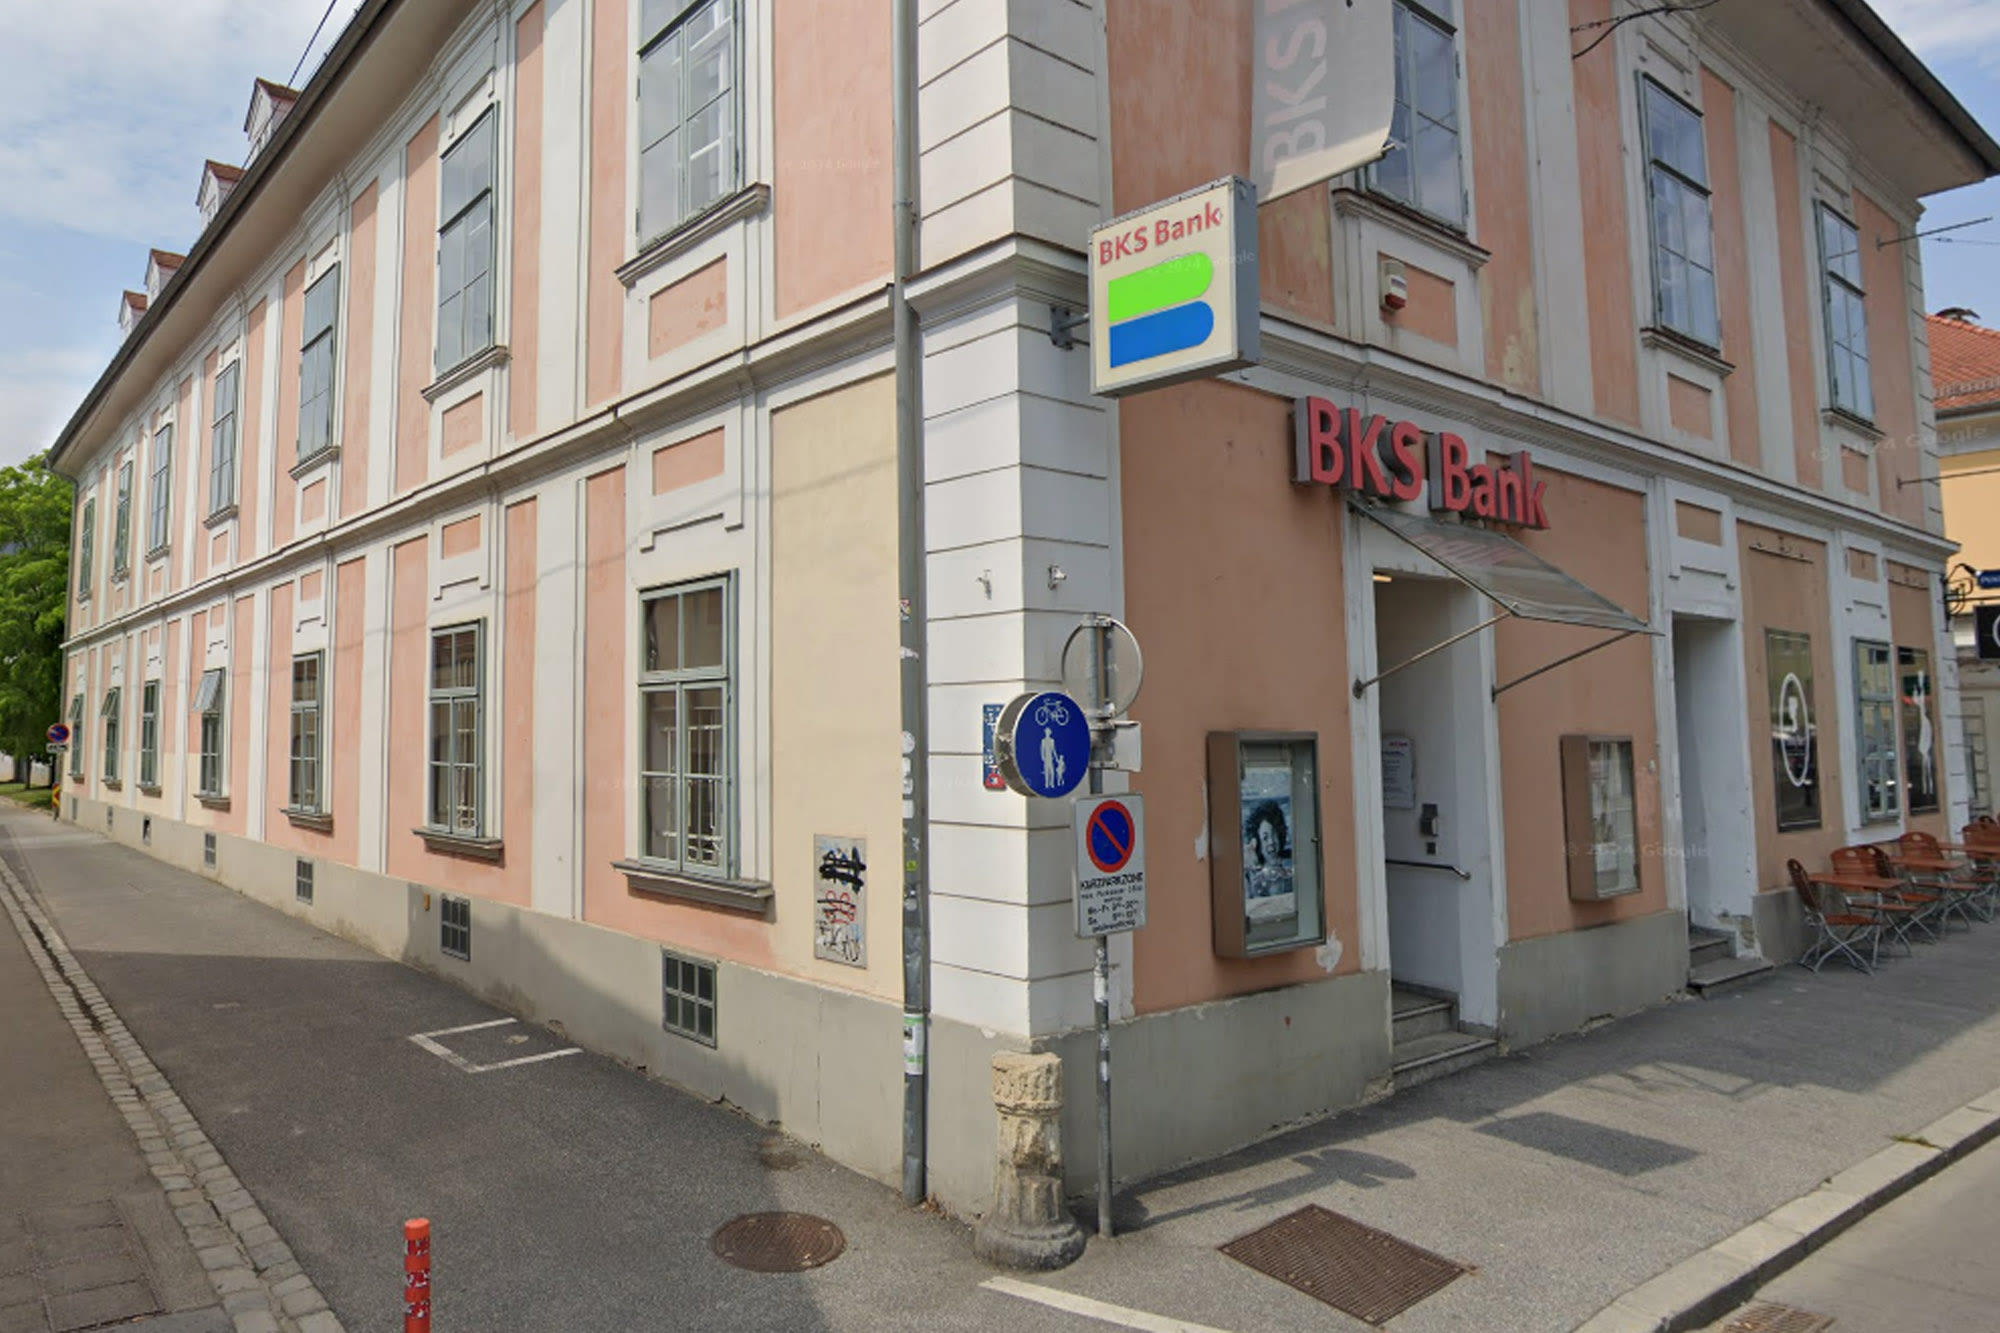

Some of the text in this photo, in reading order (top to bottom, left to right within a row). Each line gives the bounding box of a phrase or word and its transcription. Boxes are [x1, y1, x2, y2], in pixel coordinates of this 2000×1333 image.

[1264, 20, 1327, 173] BKS
[1100, 201, 1222, 265] BKS Bank
[1297, 395, 1550, 529] BKS Bank
